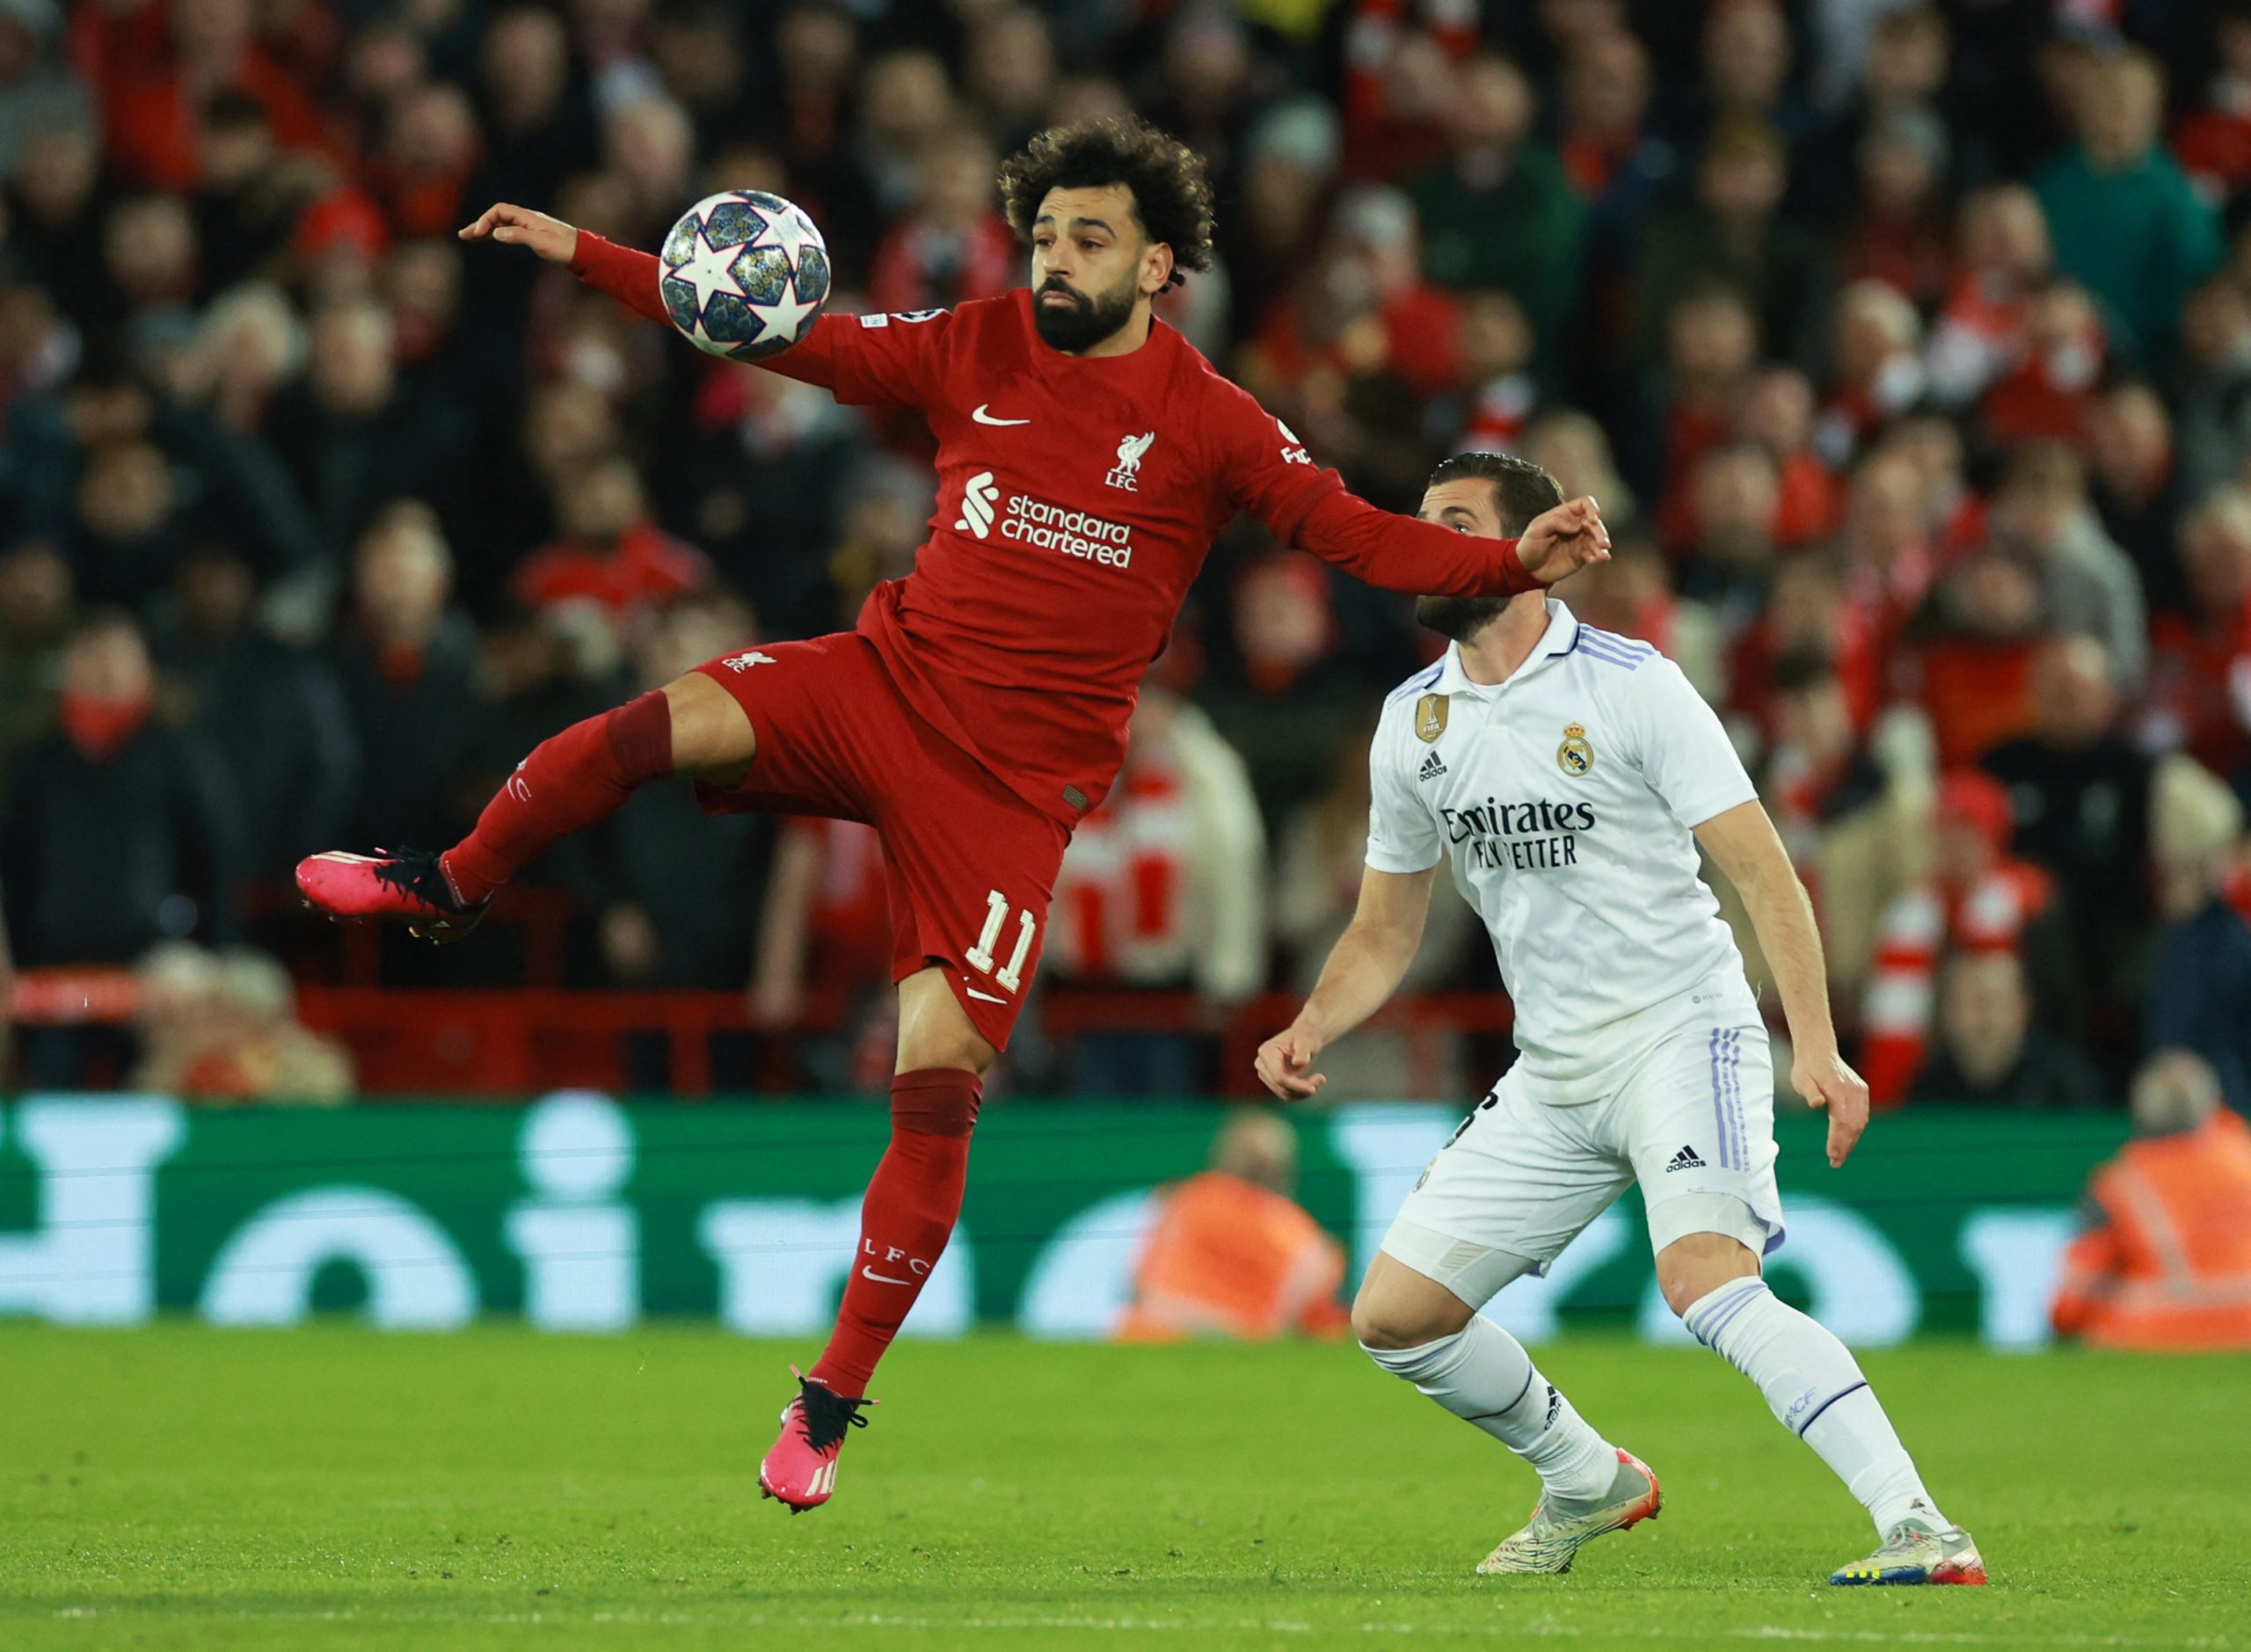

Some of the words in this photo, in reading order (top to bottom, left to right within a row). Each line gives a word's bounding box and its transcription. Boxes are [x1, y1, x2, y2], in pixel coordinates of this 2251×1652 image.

[1001, 518, 1133, 568] chartered
[1007, 495, 1131, 544] standard
[1440, 797, 1595, 844] Emirates
[1504, 834, 1577, 870] ETTER
[965, 889, 1036, 994] 11
[1665, 1160, 1707, 1173] adidas
